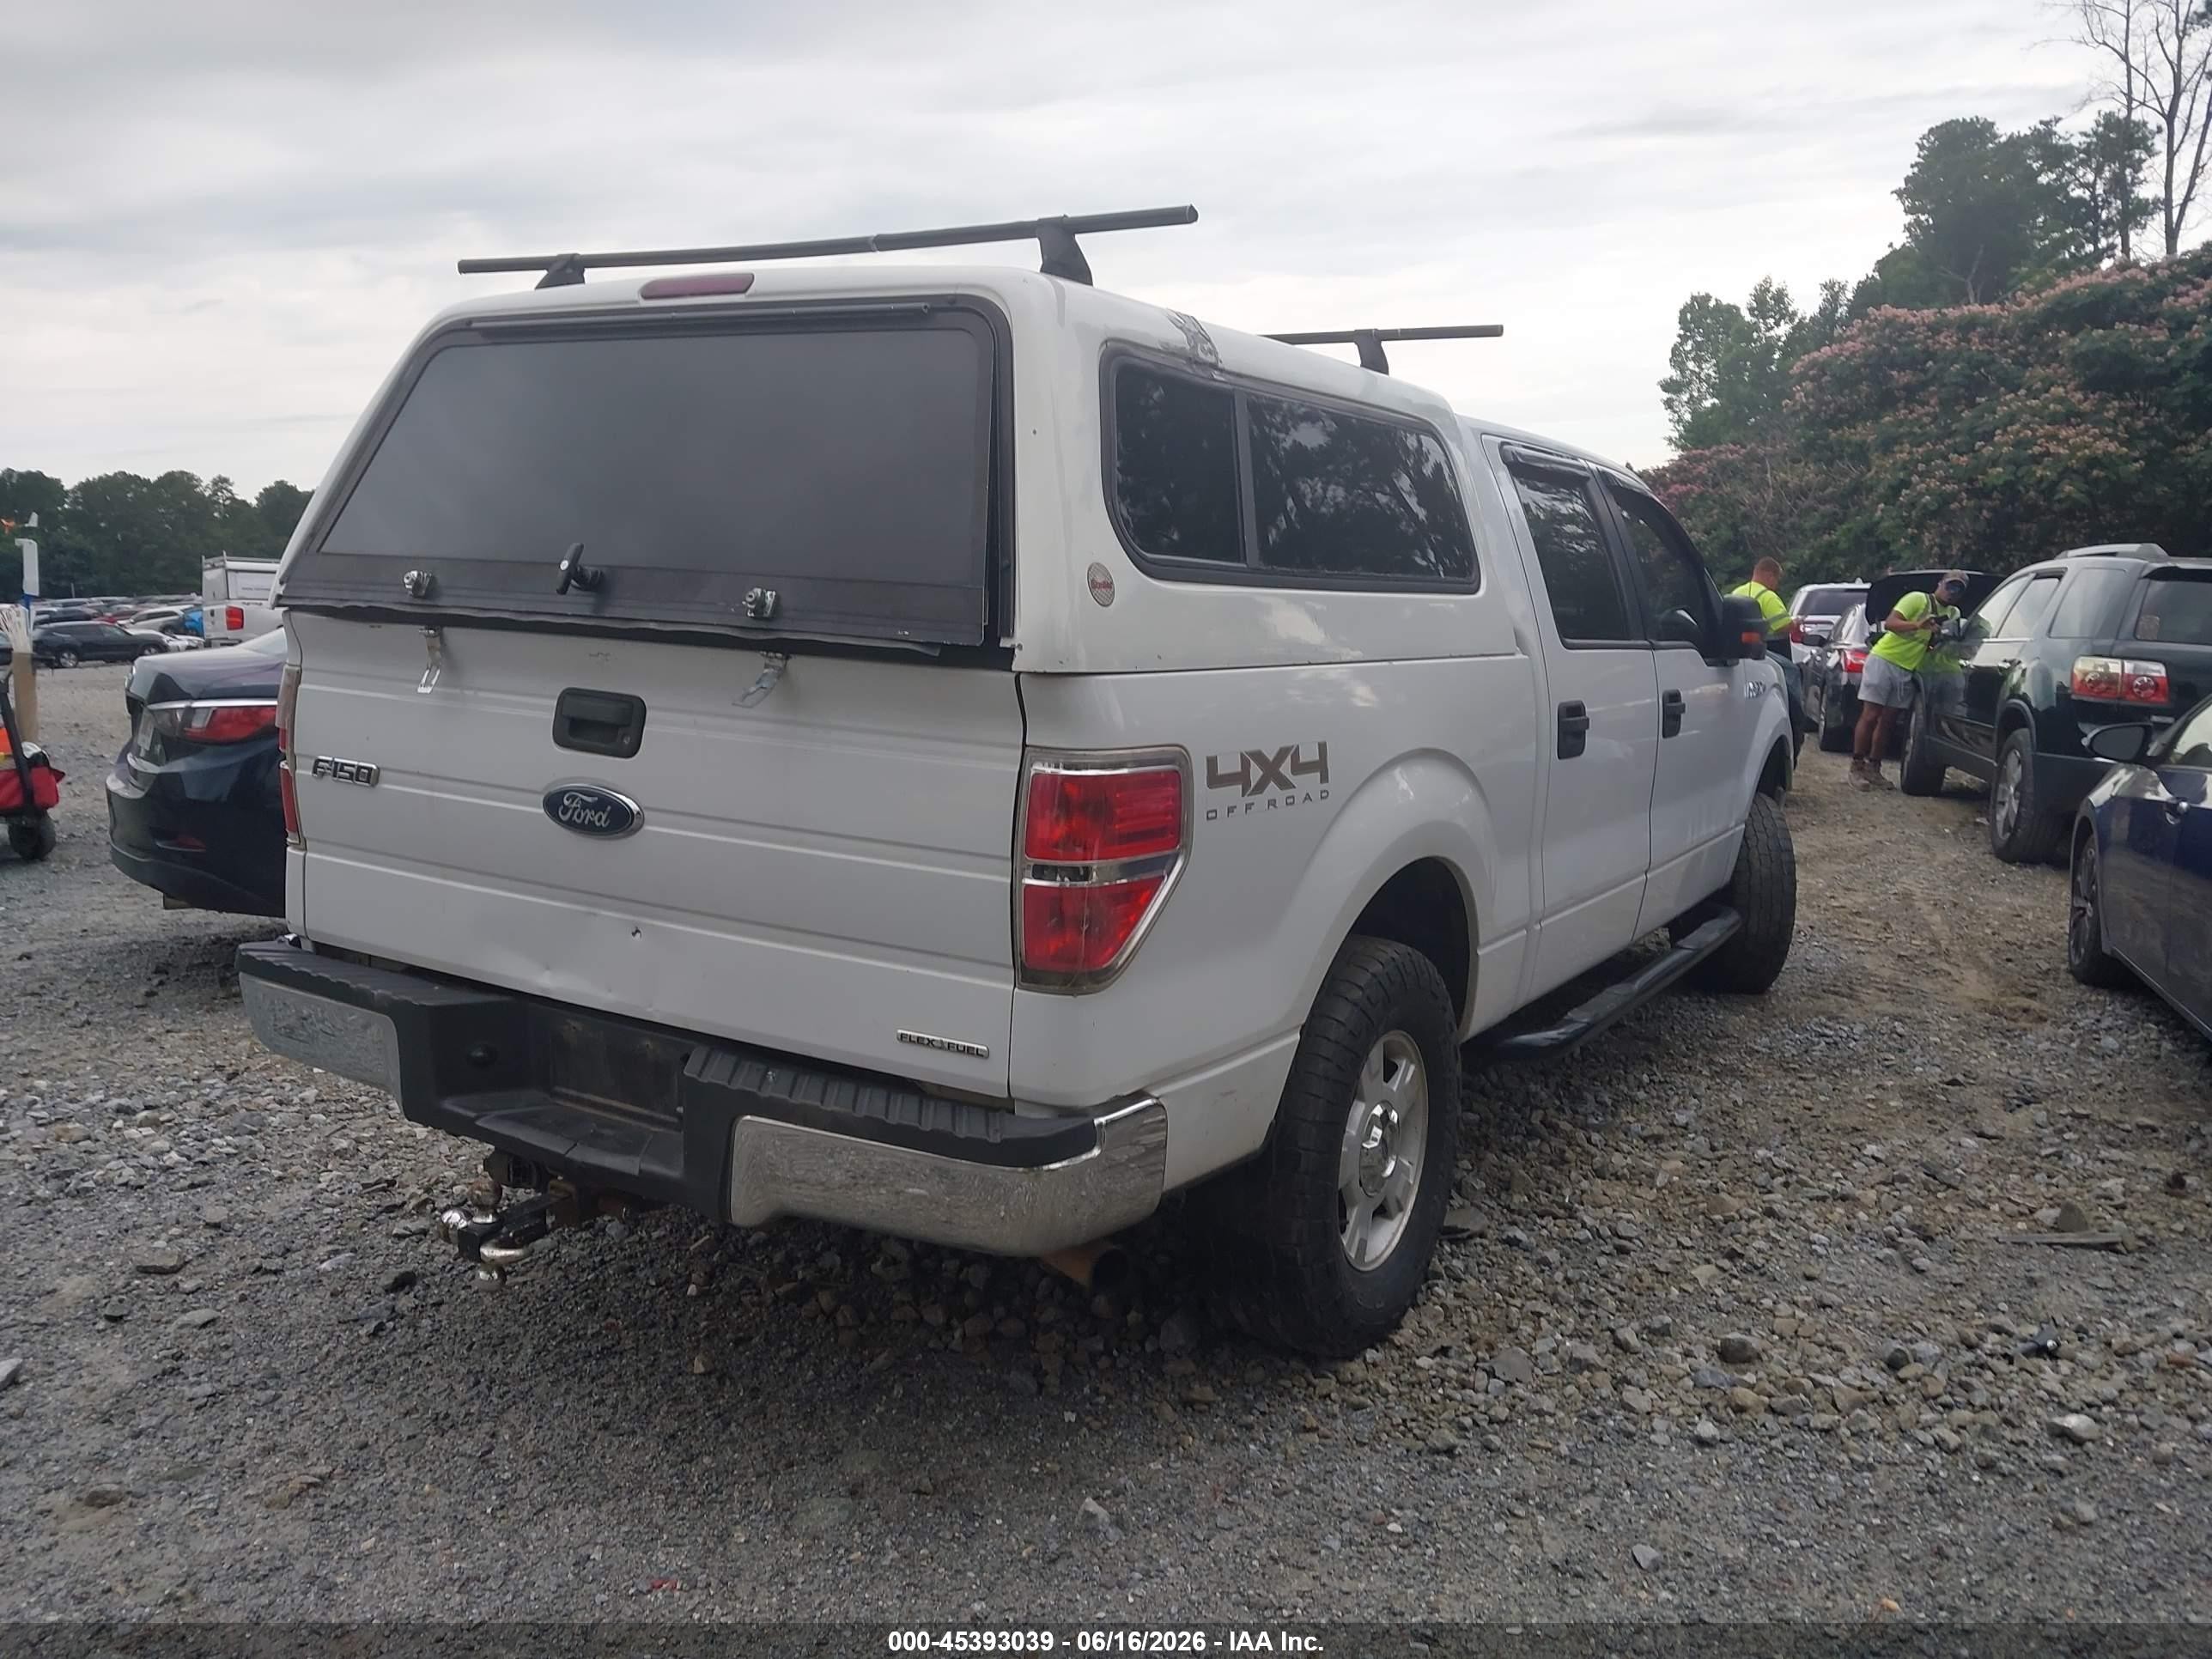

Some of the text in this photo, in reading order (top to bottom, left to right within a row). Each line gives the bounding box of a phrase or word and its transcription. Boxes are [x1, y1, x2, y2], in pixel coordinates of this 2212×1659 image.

[558, 791, 611, 828] Ford
[899, 1031, 985, 1058] FLEX FUEL
